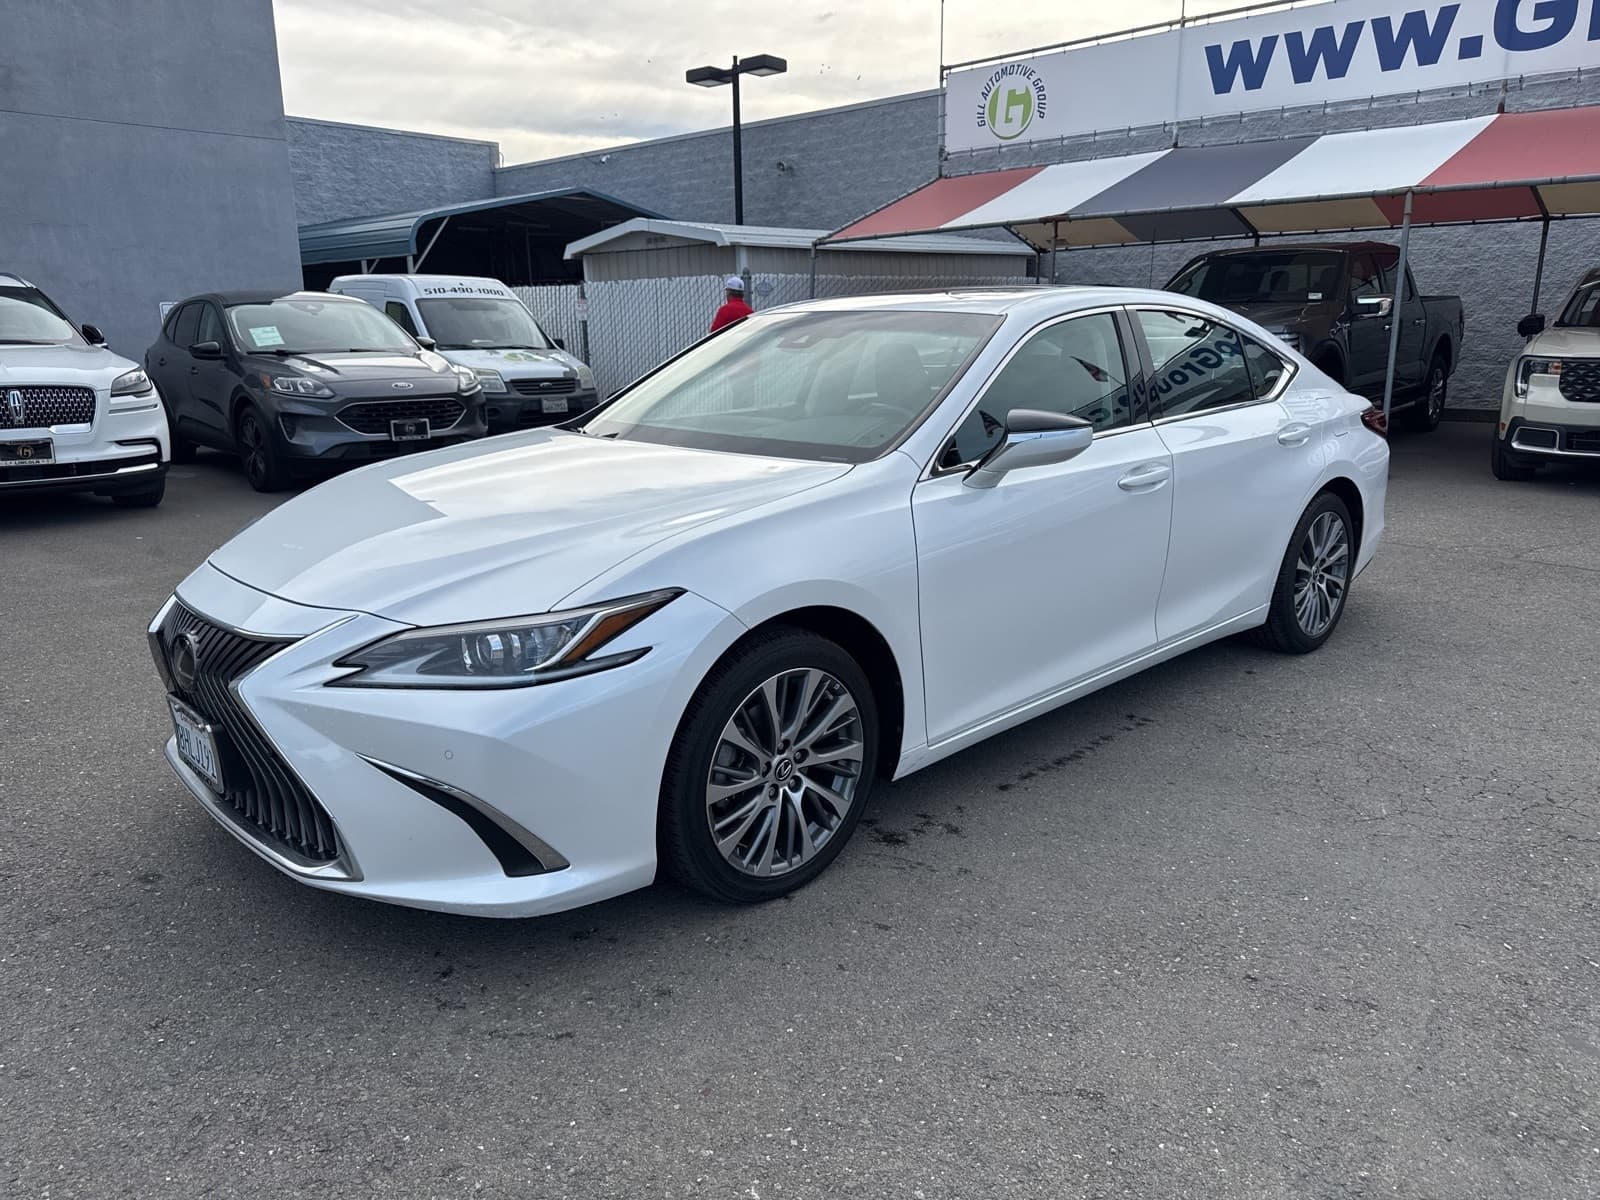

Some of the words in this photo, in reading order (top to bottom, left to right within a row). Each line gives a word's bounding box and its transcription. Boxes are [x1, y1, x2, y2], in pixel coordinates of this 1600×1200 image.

[981, 63, 1036, 101] AUTOMOTIVE
[1032, 77, 1047, 120] GROUP
[976, 103, 987, 128] GILL
[423, 286, 505, 297] 510-490-1000
